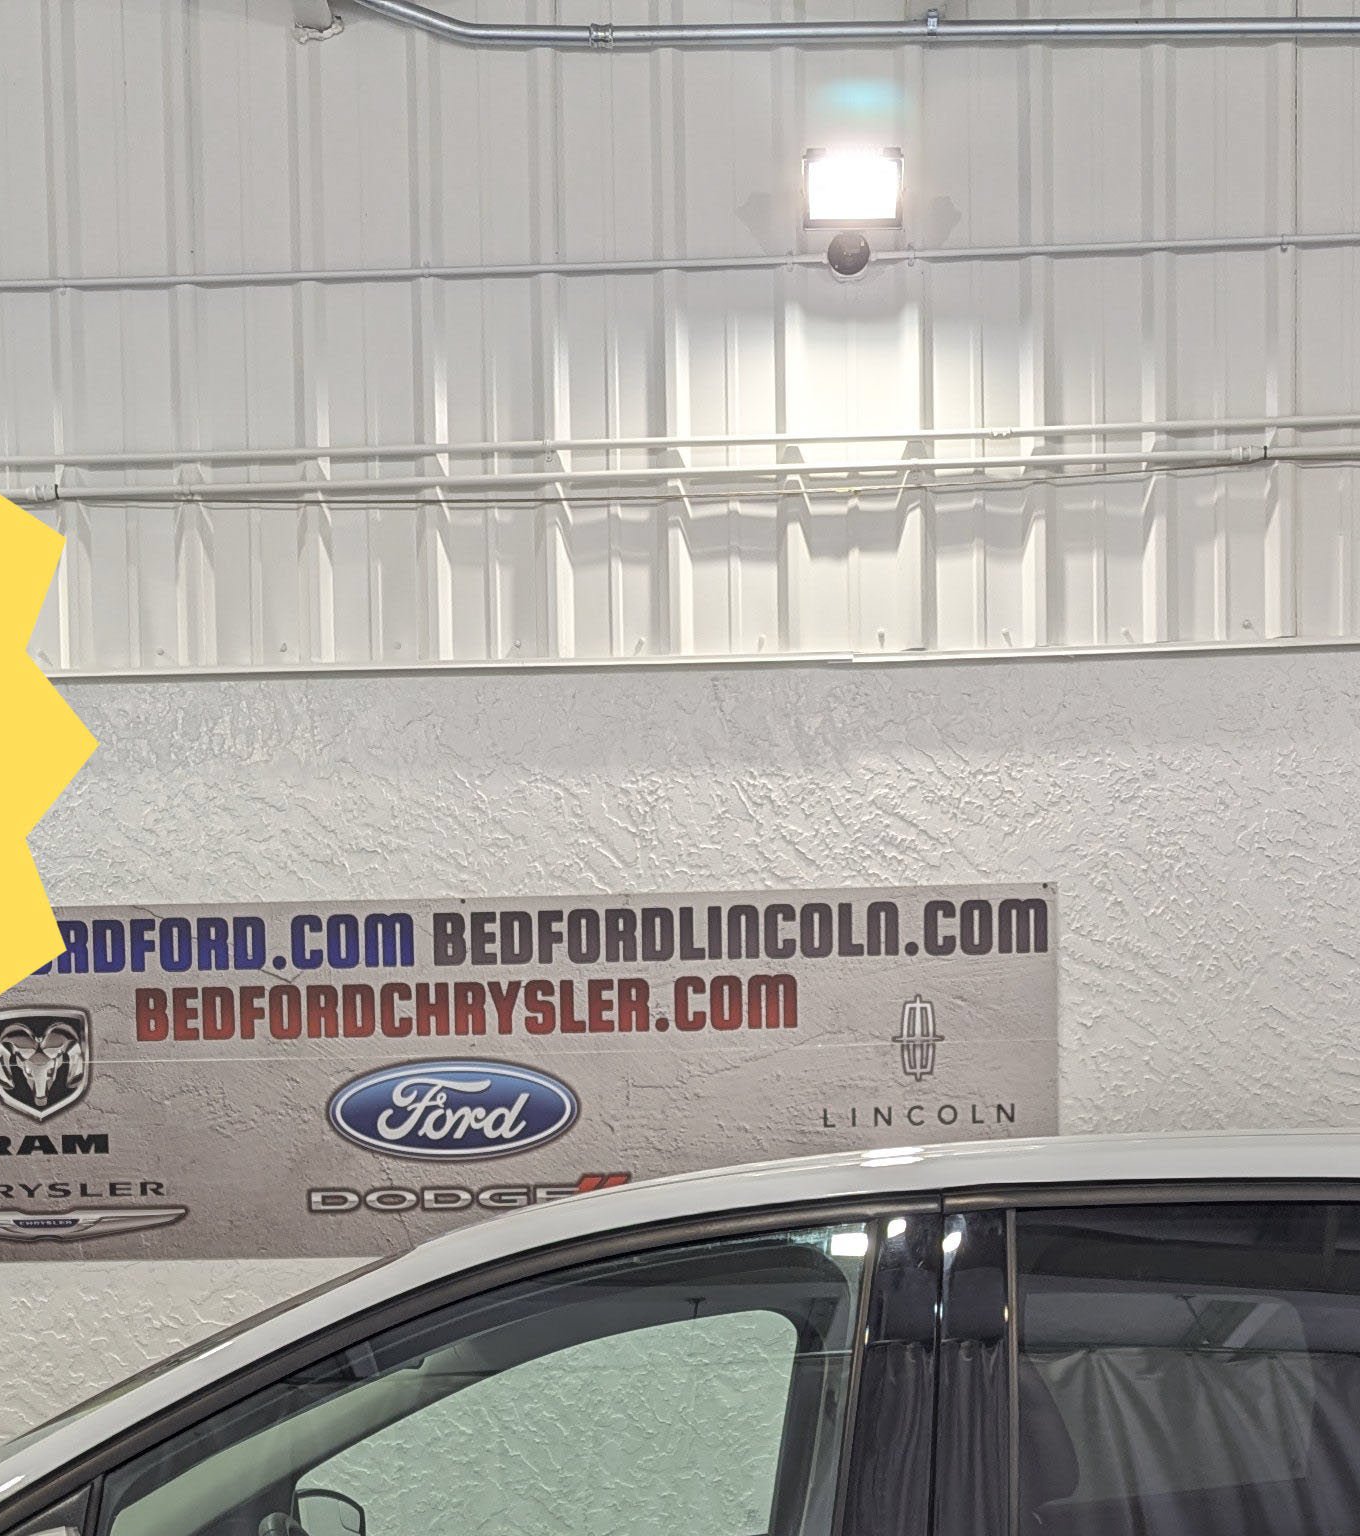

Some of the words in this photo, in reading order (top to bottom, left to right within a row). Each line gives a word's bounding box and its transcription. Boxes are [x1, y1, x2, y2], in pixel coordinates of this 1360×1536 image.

[31, 912, 414, 975] RDFORD.COM
[432, 897, 1049, 967] BEDFORDLINCOLN.COM
[134, 973, 799, 1042] BEDFORDCHRYSLER.COM
[376, 1077, 530, 1140] Ford
[822, 1103, 1016, 1128] LINCOLN
